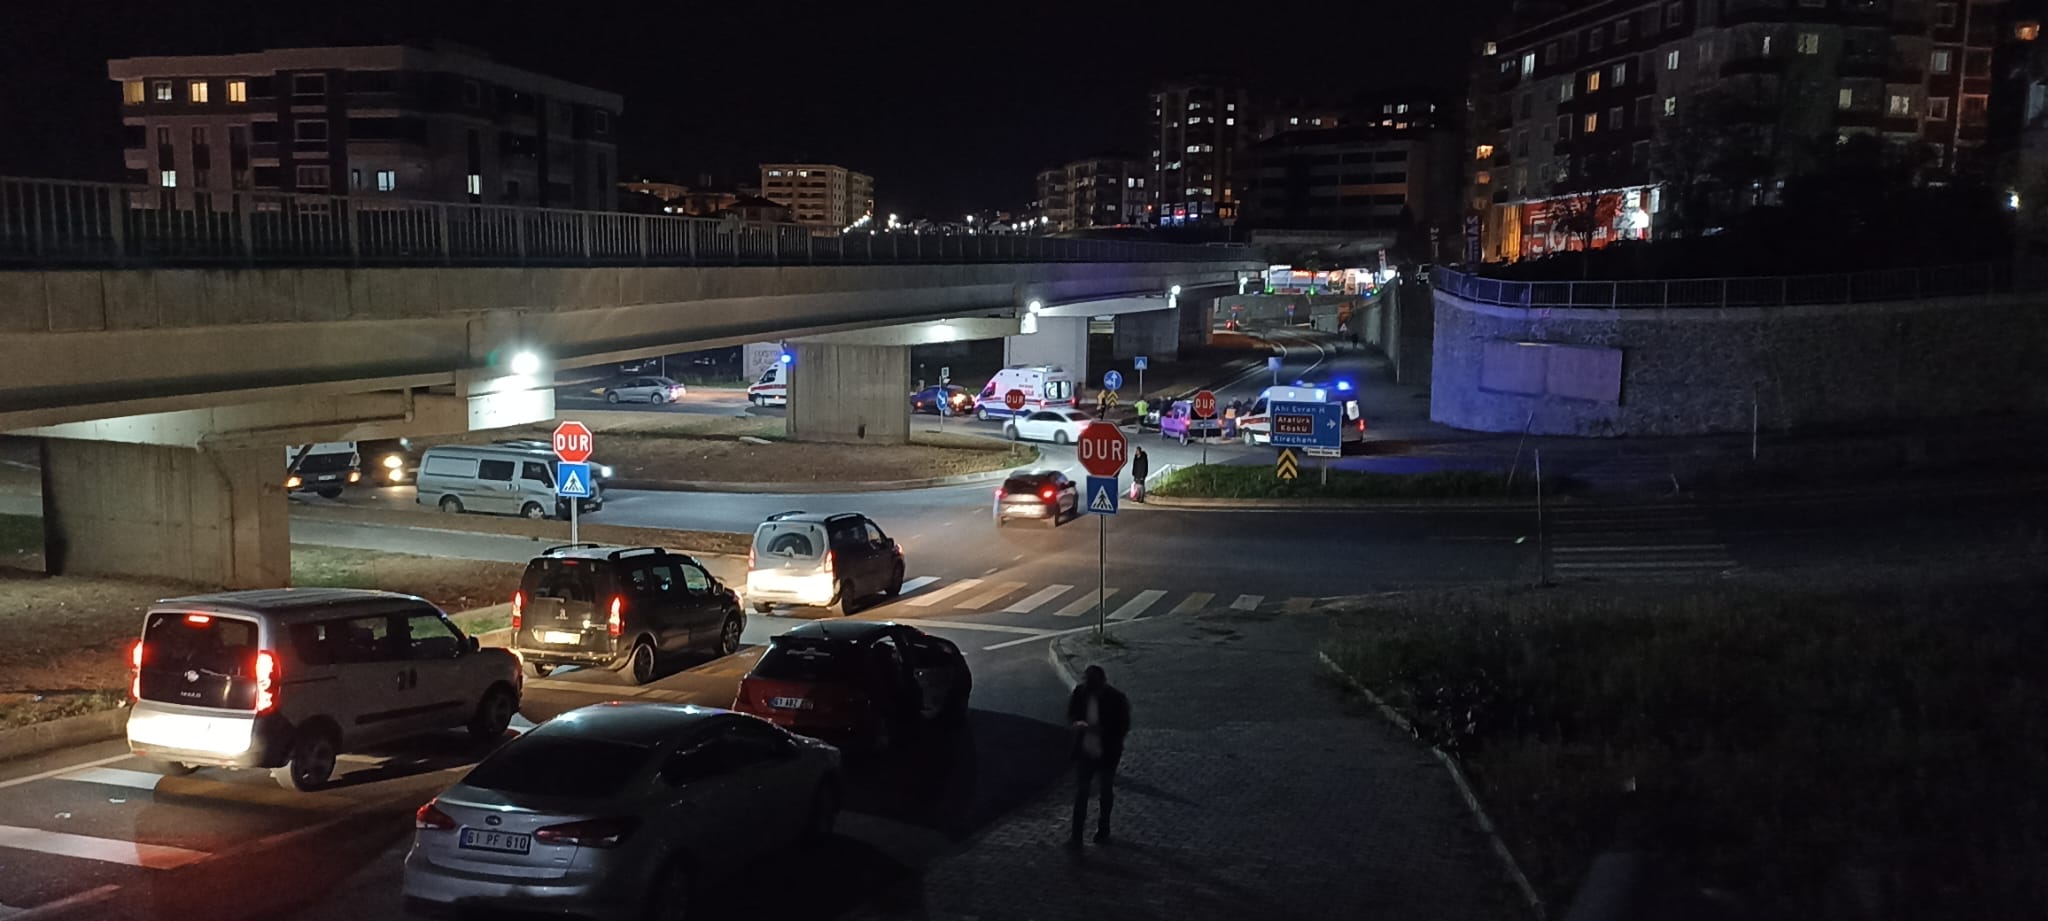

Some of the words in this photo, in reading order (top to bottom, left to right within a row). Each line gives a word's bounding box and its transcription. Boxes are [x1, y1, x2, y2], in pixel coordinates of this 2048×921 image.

[1006, 394, 1024, 404] DUR
[1195, 399, 1215, 409] DUR
[1278, 416, 1310, 424] Atatürk
[556, 434, 589, 451] DUR
[1082, 439, 1122, 461] DUR
[486, 834, 500, 846] PF
[506, 836, 527, 849] 610
